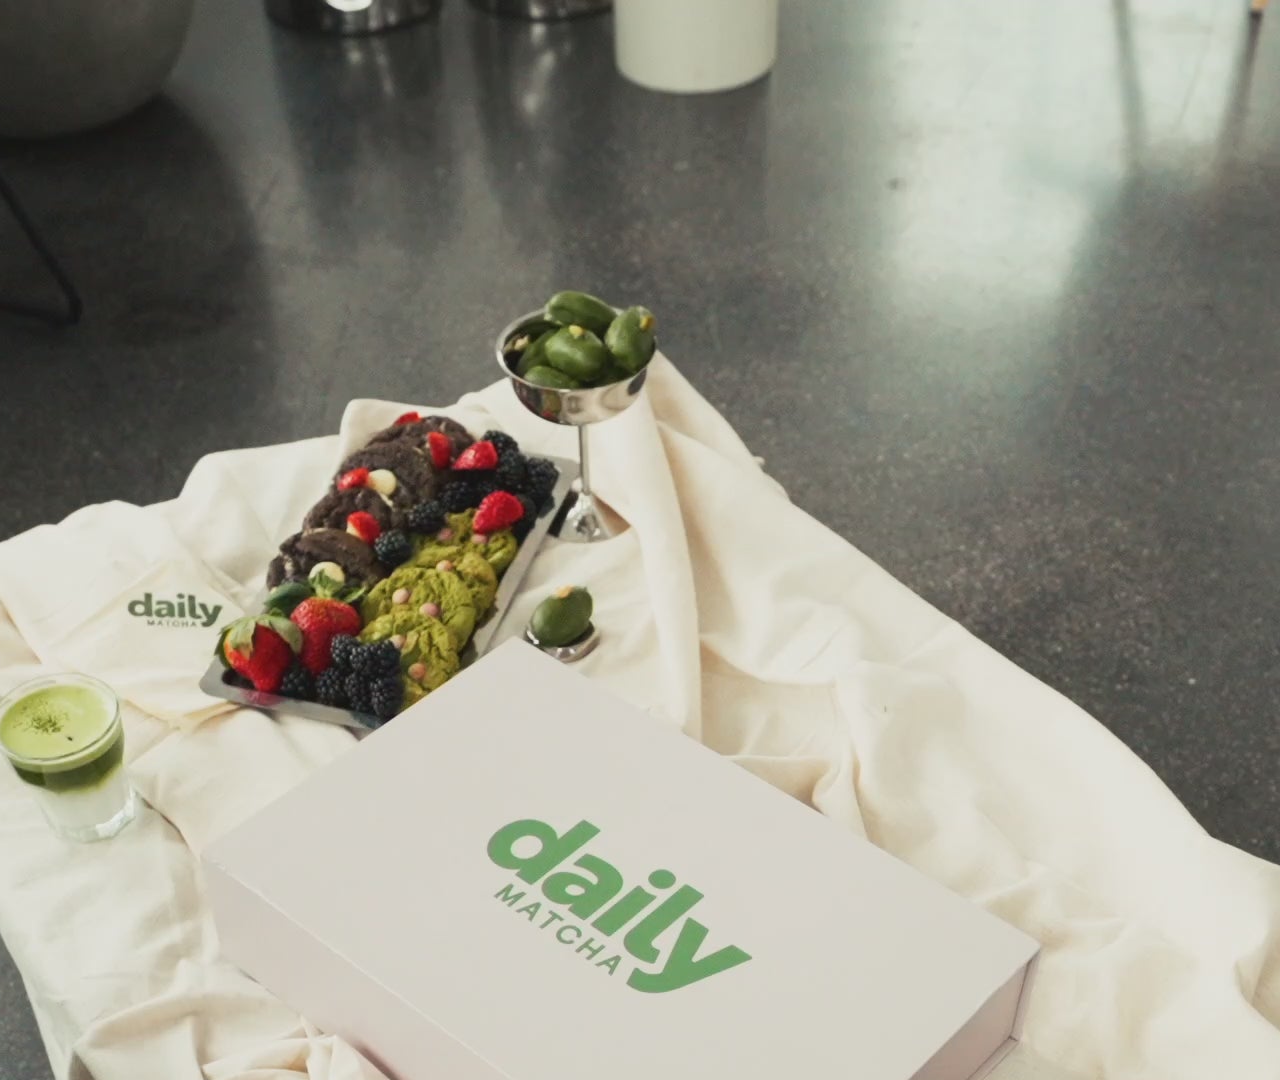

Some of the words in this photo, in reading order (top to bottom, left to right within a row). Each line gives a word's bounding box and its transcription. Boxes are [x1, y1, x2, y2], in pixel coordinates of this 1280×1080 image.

[127, 592, 222, 627] daily
[147, 619, 198, 628] MATCHA
[486, 818, 753, 994] daily
[493, 883, 622, 976] MATCHA
